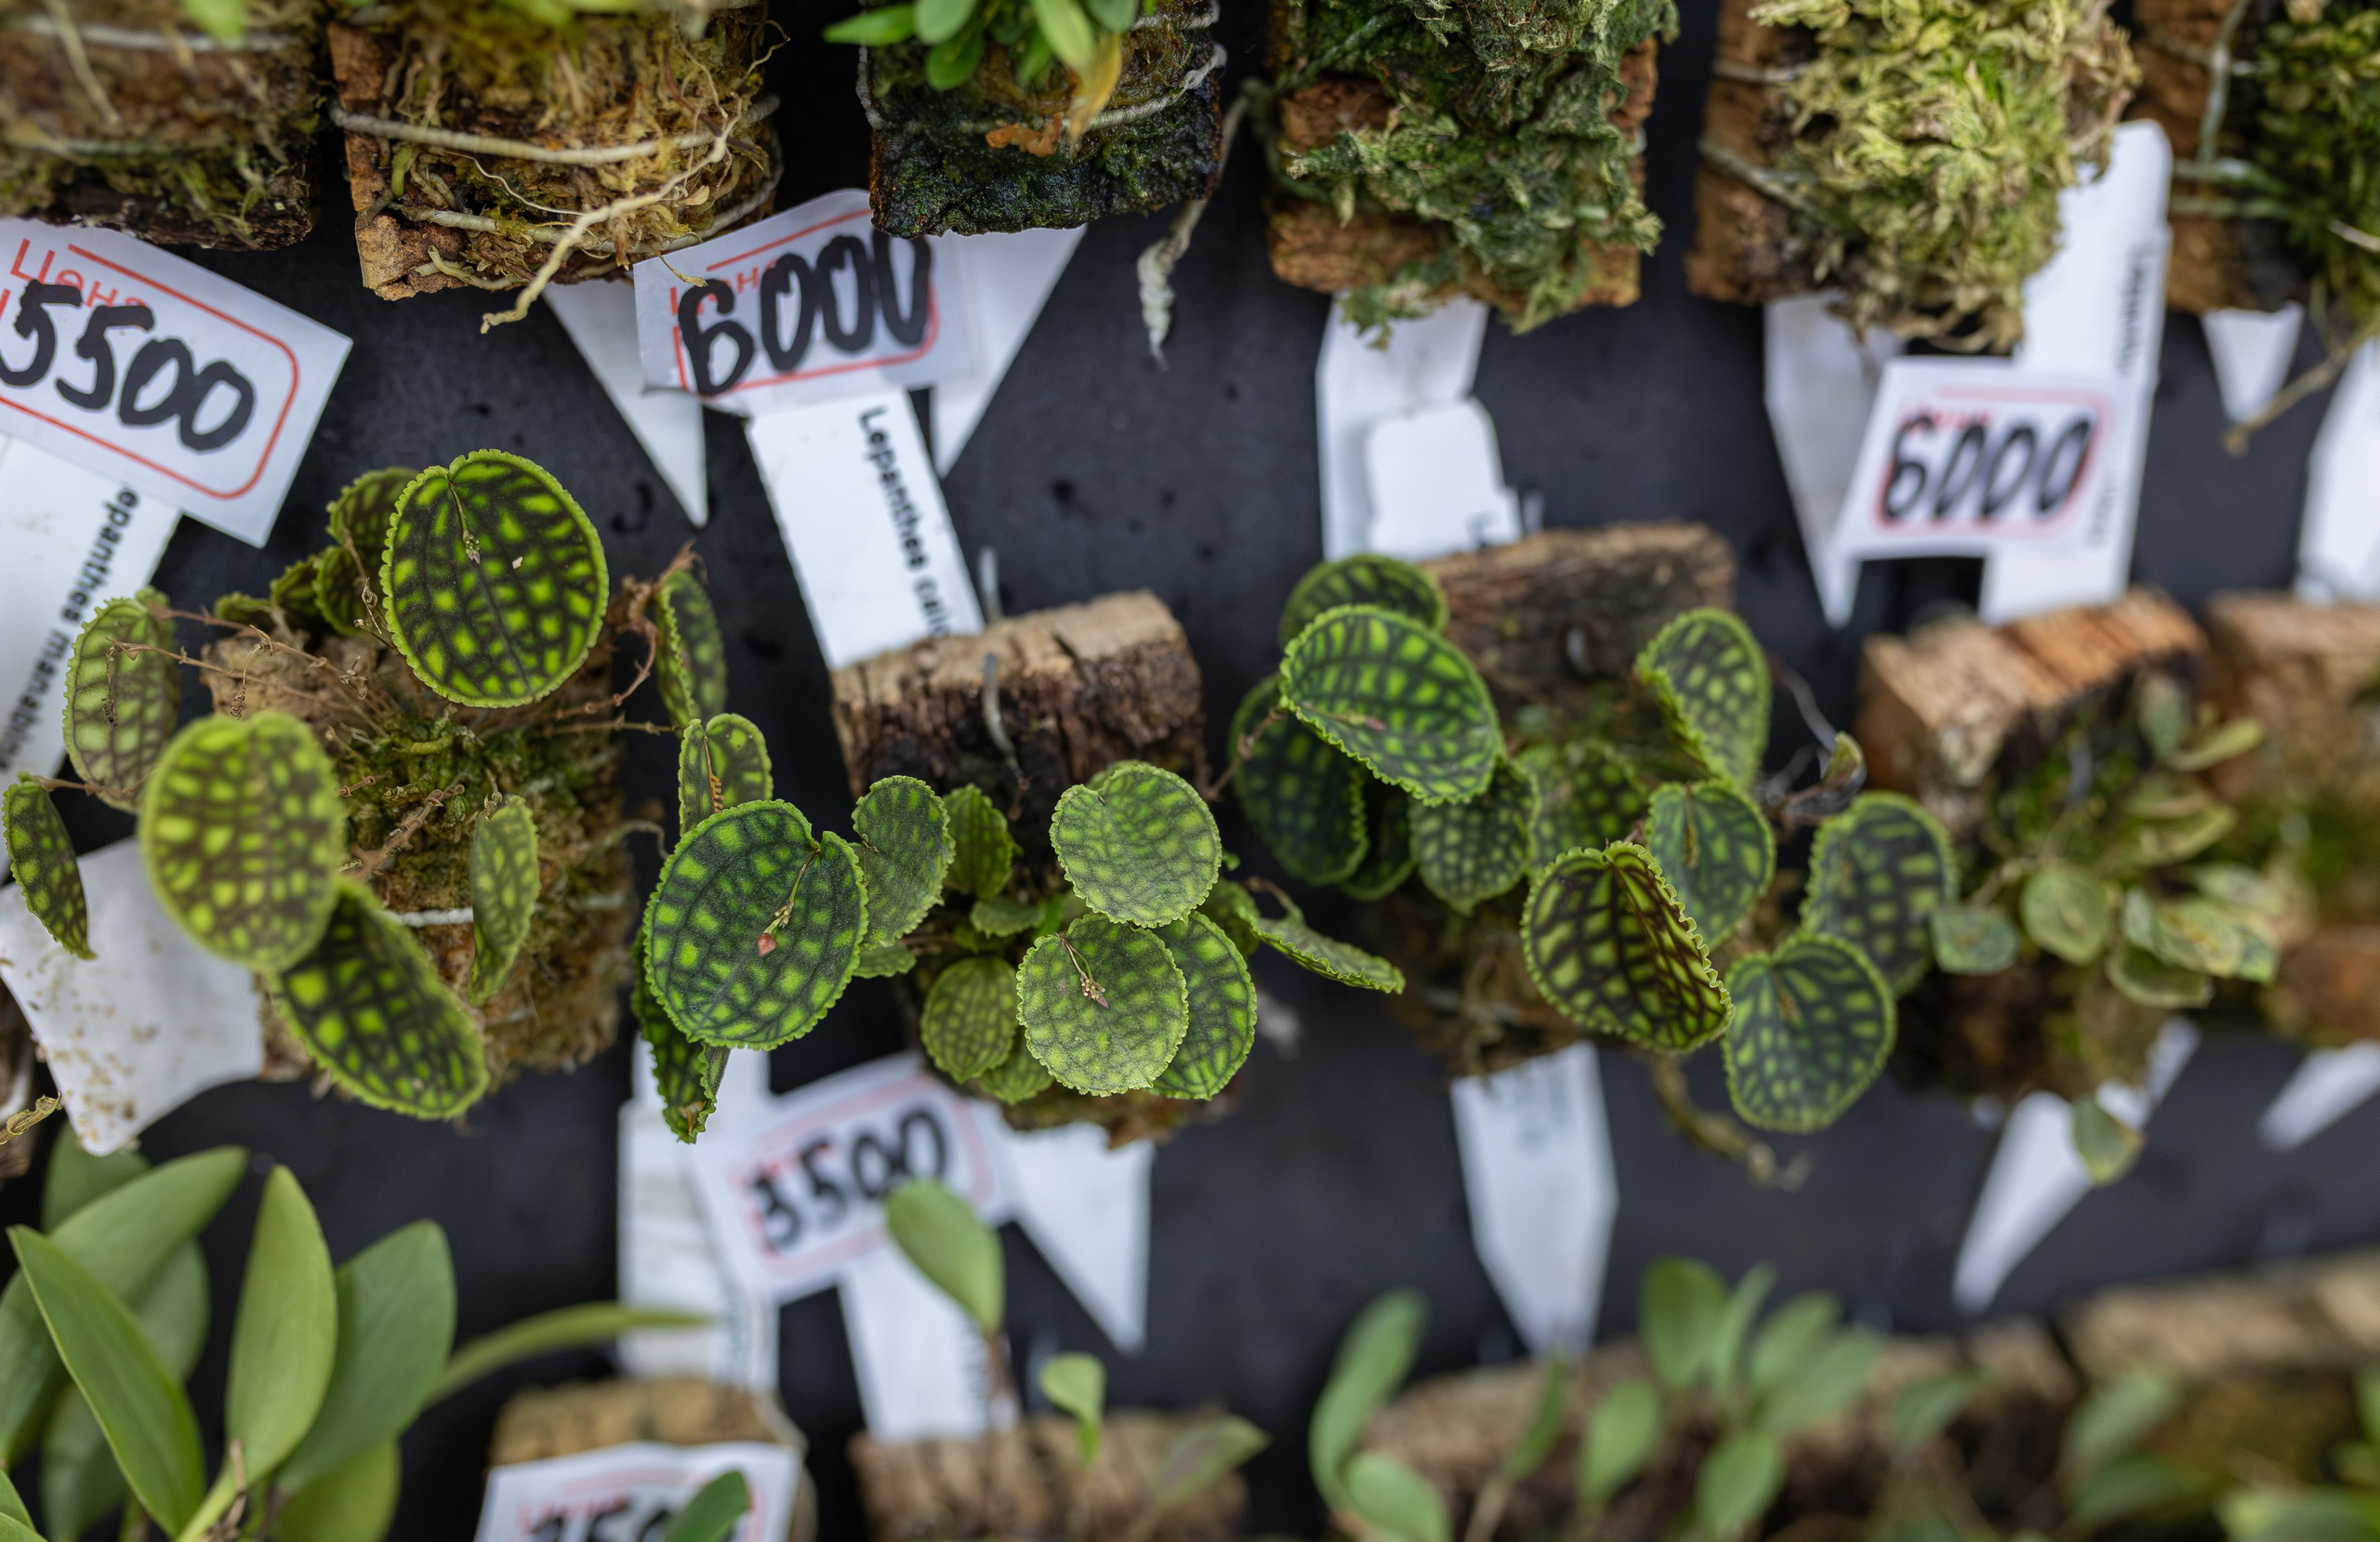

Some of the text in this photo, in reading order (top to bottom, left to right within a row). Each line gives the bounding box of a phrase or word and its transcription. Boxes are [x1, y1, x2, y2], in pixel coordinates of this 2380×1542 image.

[0, 279, 255, 452] 5500
[679, 230, 931, 395] 6000
[858, 405, 930, 572] Lepanthes
[1883, 415, 2091, 521] 6000
[60, 486, 140, 624] epanthes
[753, 1111, 946, 1248] 3500
